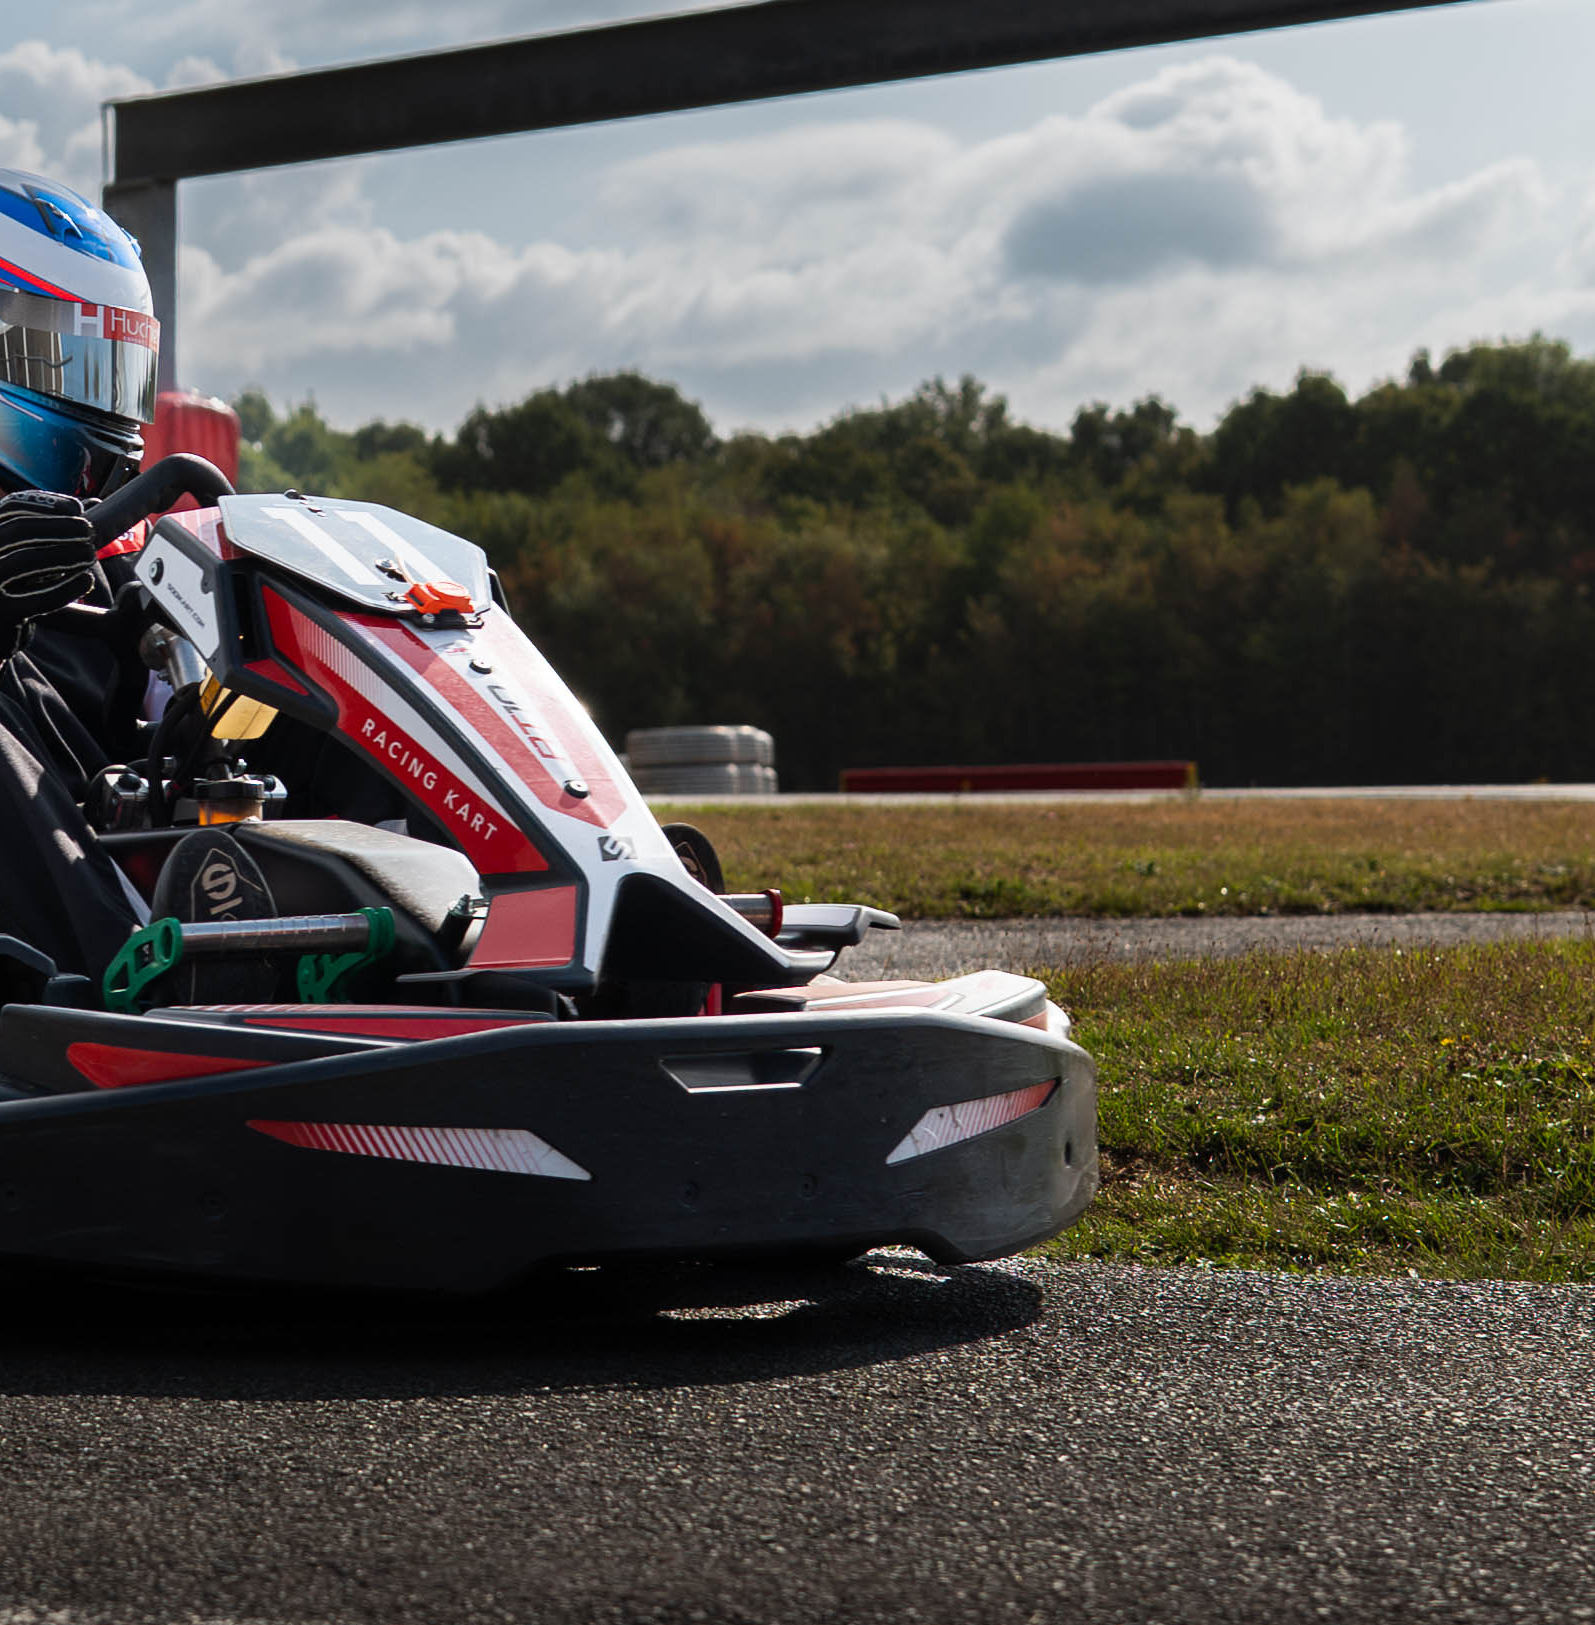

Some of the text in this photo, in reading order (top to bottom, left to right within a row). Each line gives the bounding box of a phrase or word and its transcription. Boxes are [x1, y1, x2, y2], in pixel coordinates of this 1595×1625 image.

[260, 507, 460, 586] 11
[361, 718, 498, 840] RACING KART
